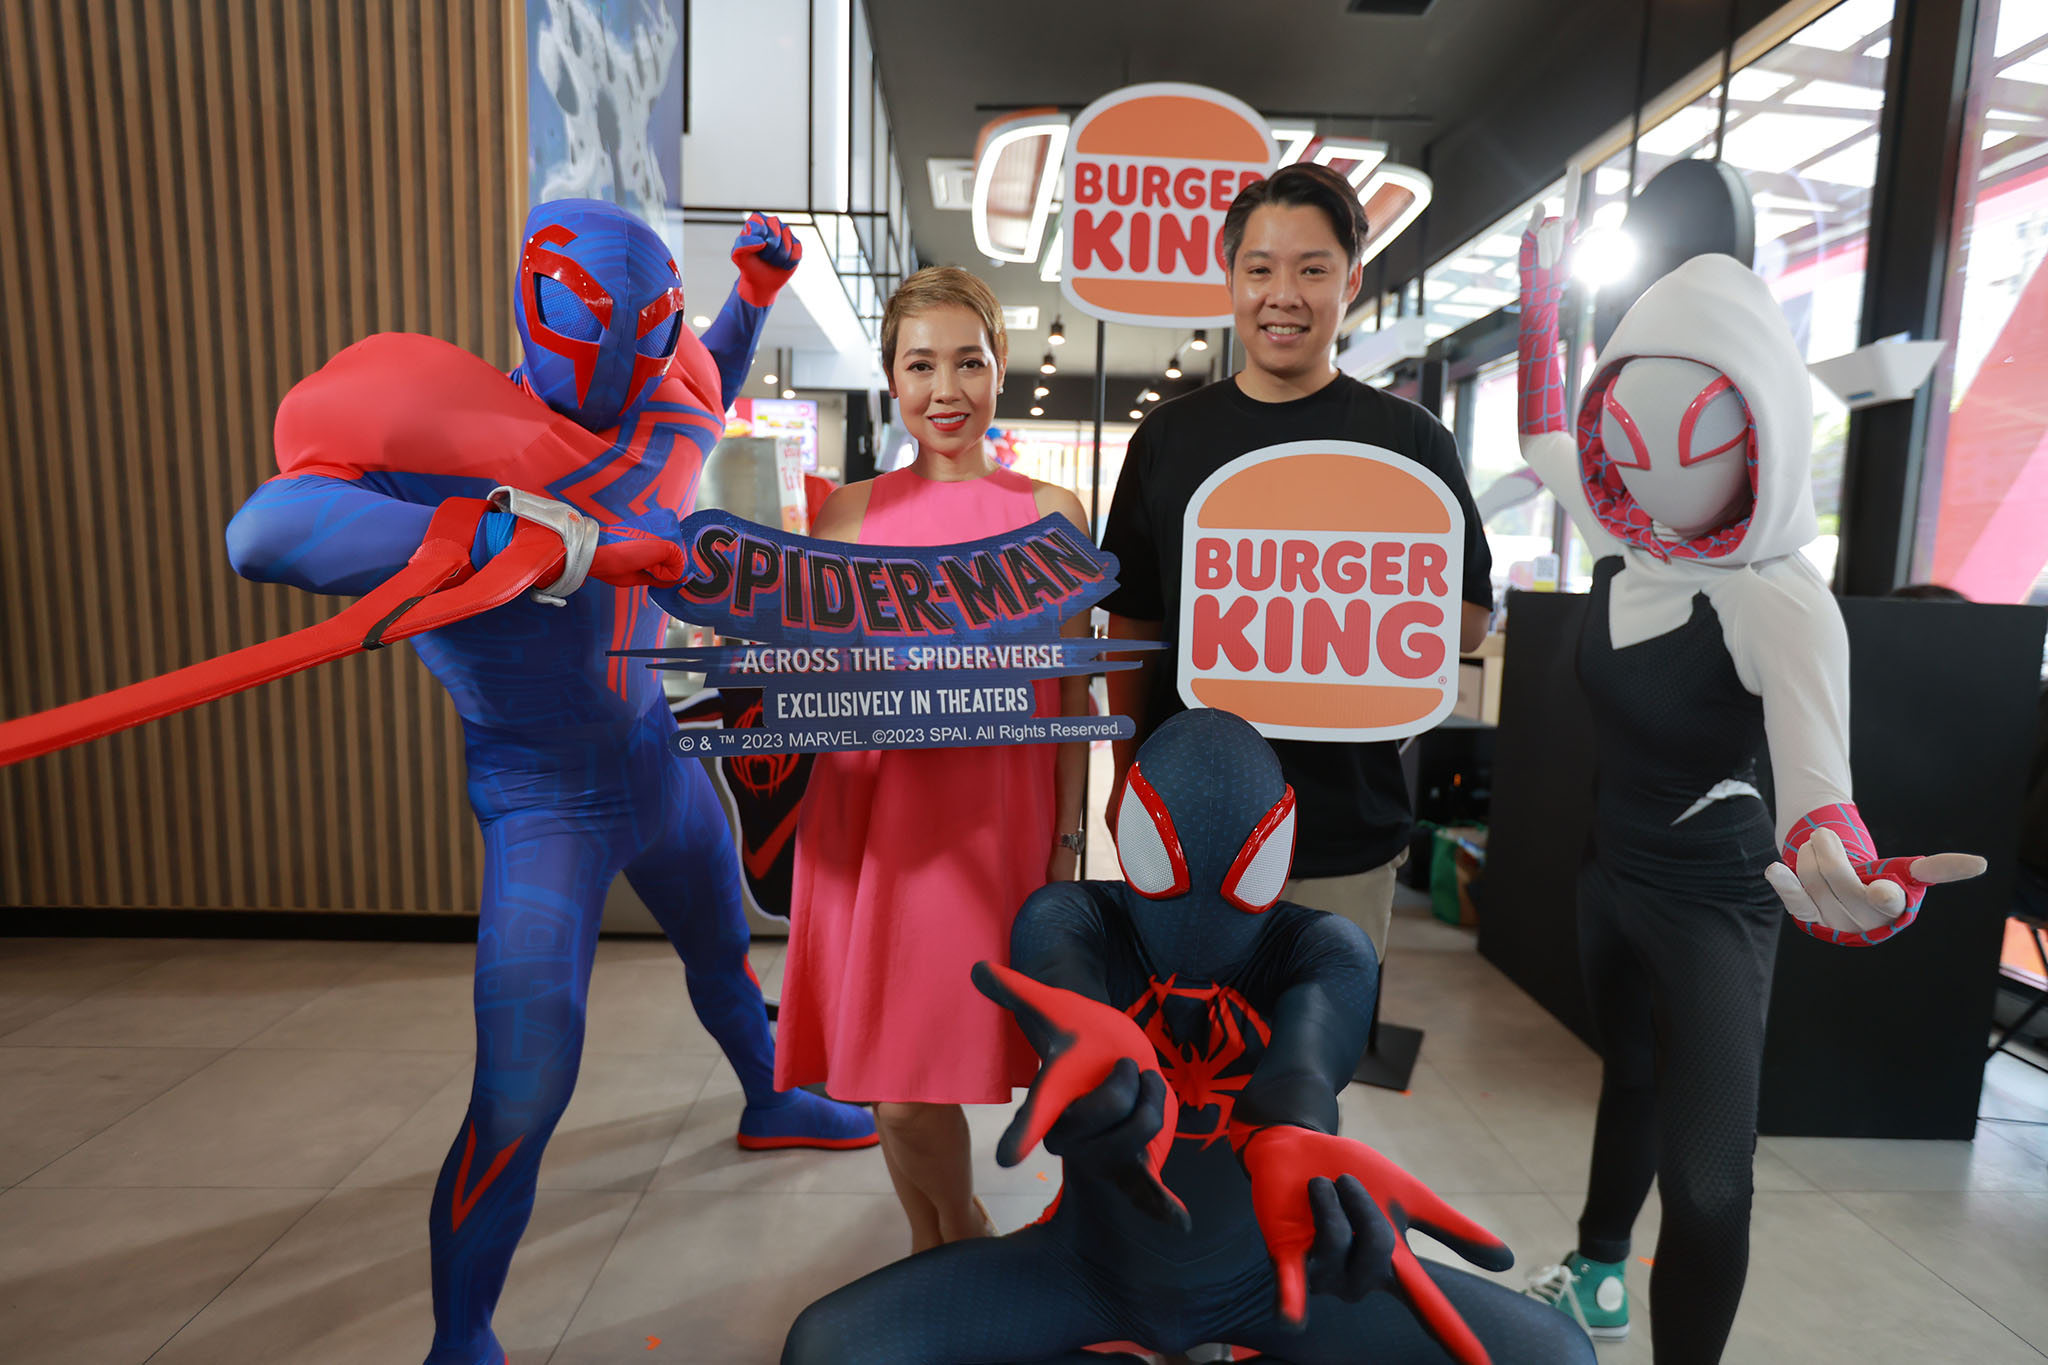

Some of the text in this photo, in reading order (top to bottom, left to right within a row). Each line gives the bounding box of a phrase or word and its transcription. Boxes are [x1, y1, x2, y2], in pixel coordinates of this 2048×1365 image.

[1072, 208, 1226, 276] KIN
[679, 524, 1105, 637] SPIDER-MAN
[1194, 537, 1449, 597] BURGER
[741, 644, 1065, 673] ACROSS THE SPIDER-VERSE
[1191, 594, 1446, 680] KING
[777, 687, 1029, 719] EXCLUSIVELY IN THEATERS
[699, 735, 713, 751] &
[741, 733, 784, 750] 2023
[789, 730, 868, 747] MARVEL.
[871, 728, 925, 745] ©2023
[929, 726, 972, 742] SPAI.
[975, 724, 995, 740] All
[1000, 723, 1047, 742] Rights
[1051, 720, 1123, 738] Reserved.
